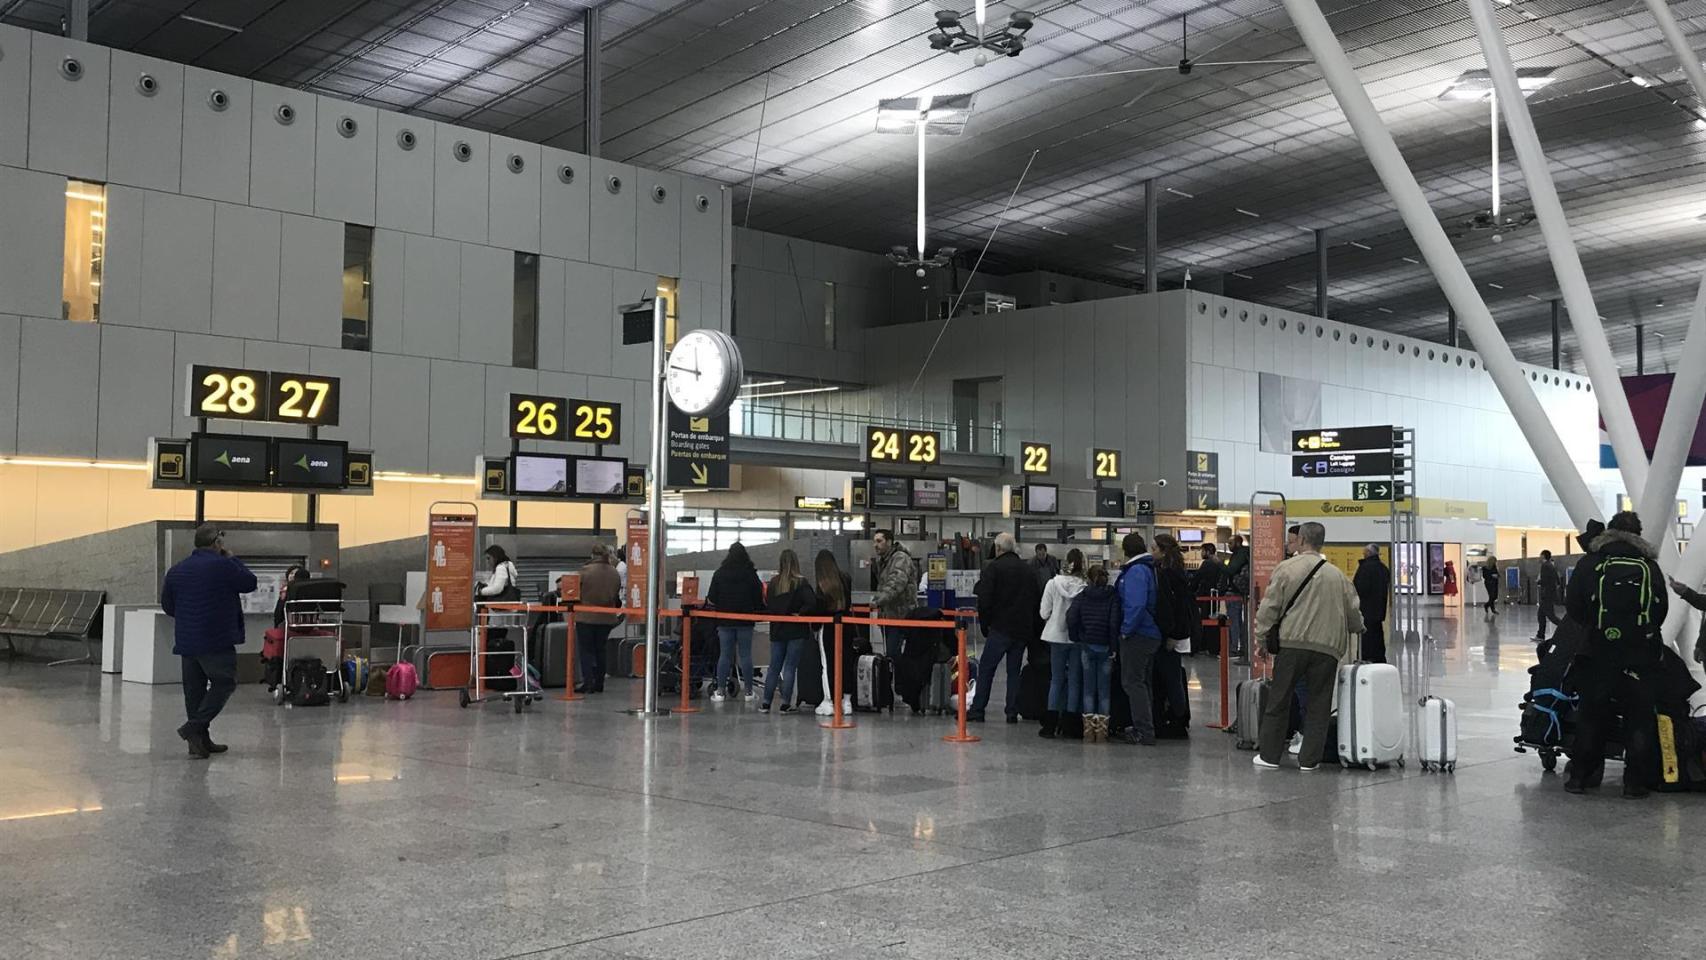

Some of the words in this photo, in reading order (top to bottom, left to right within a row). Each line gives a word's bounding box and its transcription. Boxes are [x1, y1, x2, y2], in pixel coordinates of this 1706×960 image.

[201, 374, 256, 414] 28
[278, 380, 329, 418] 27
[516, 401, 558, 435] 26
[575, 405, 613, 439] 25
[671, 440, 694, 450] Boarding
[698, 434, 724, 442] embarque
[871, 431, 900, 460] 24
[909, 434, 936, 462] 23
[231, 455, 251, 463] aena
[310, 459, 328, 467] aena
[701, 452, 727, 460] embarque
[1024, 446, 1048, 472] 22
[1096, 452, 1117, 477] 21
[1333, 504, 1364, 513] Correos
